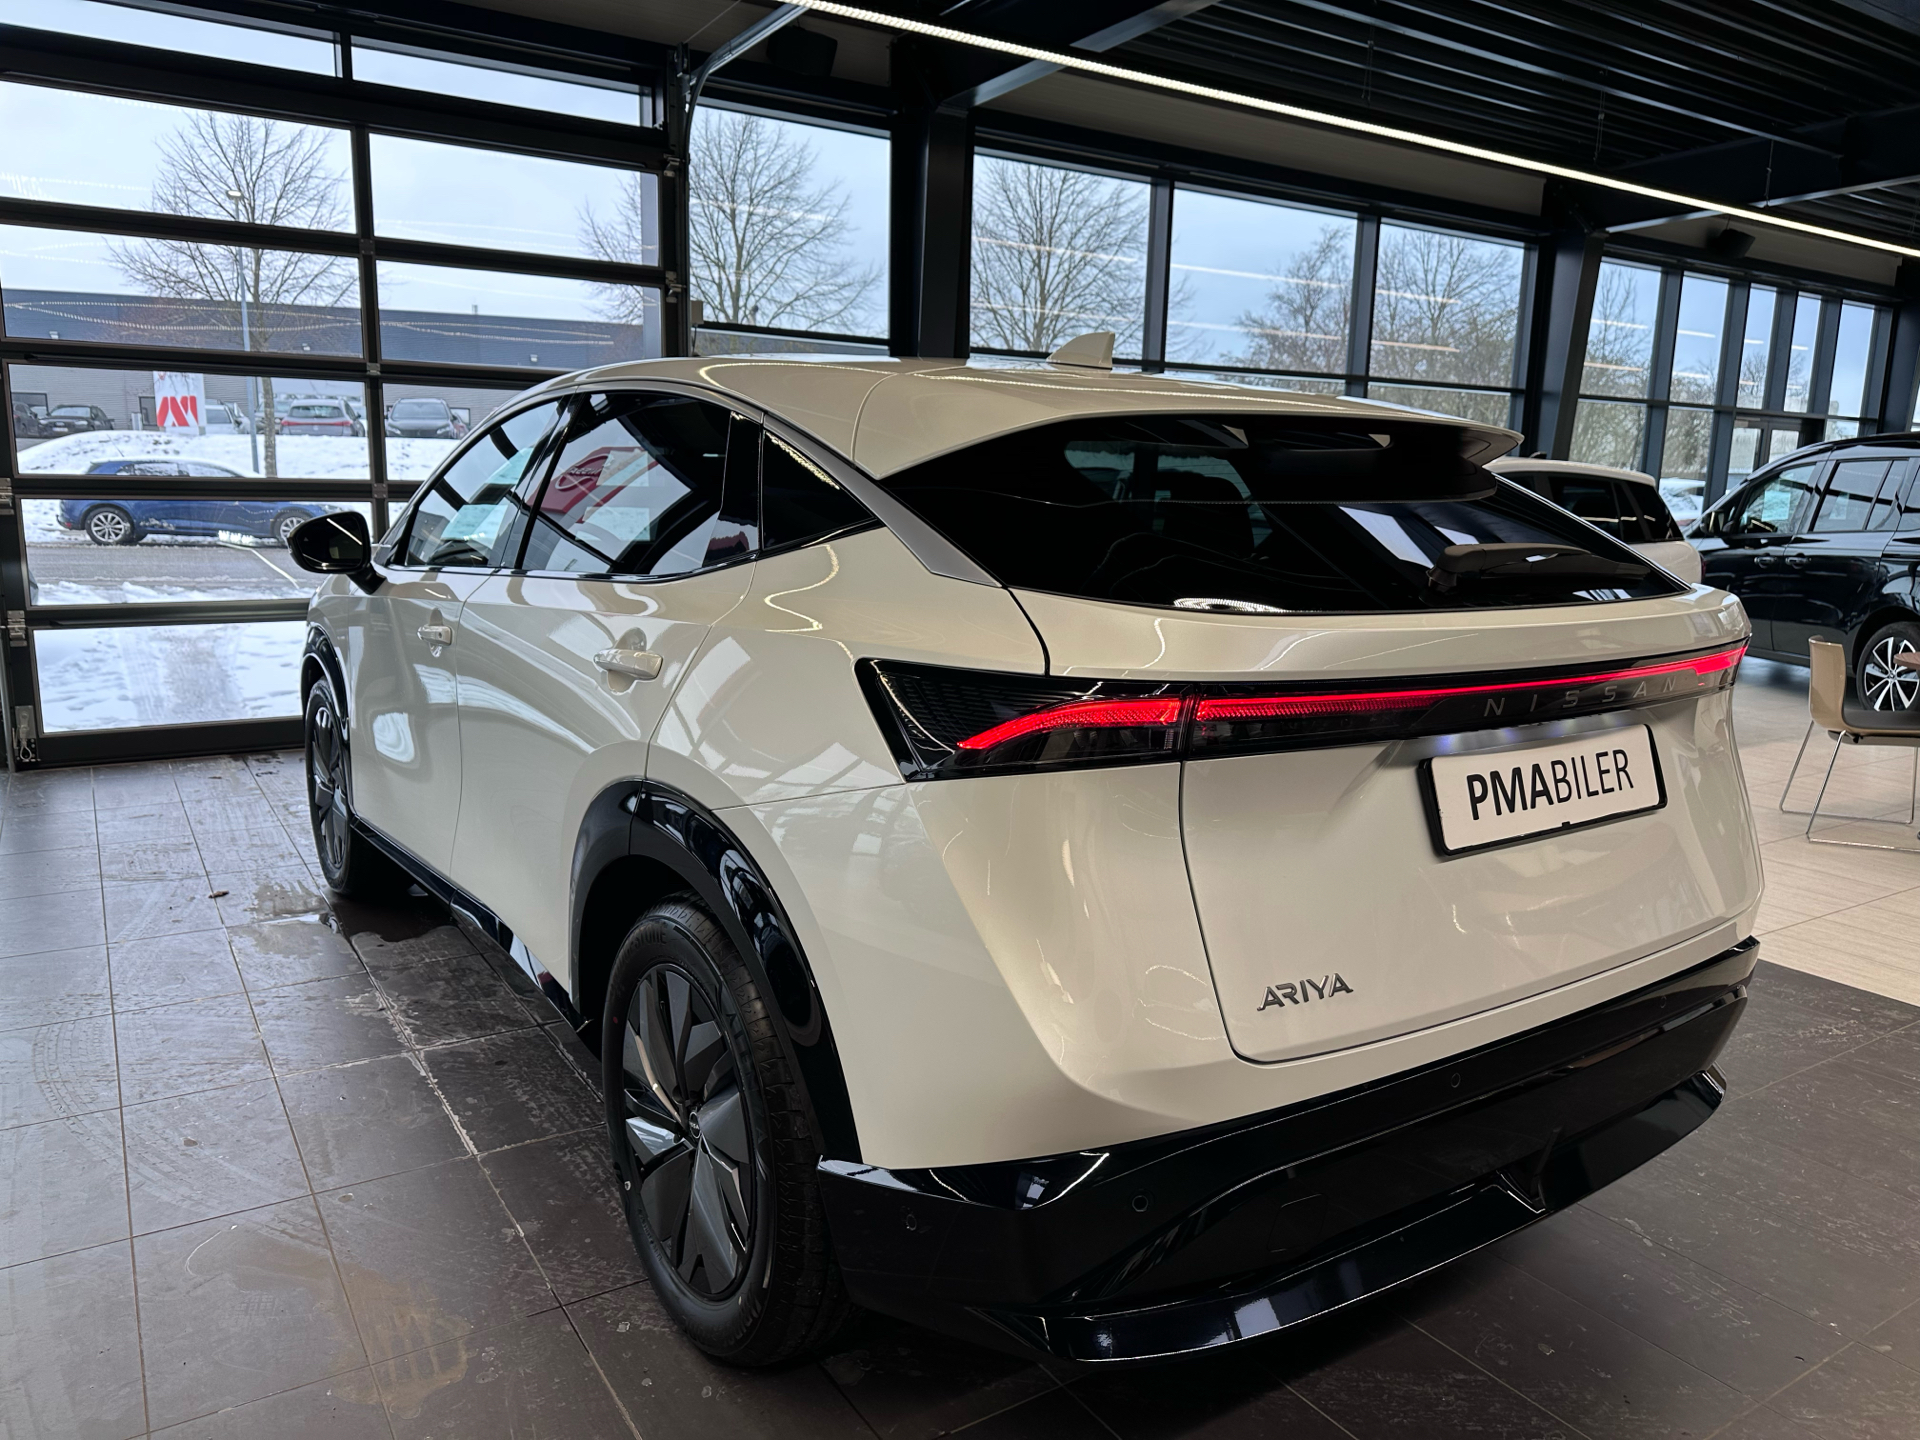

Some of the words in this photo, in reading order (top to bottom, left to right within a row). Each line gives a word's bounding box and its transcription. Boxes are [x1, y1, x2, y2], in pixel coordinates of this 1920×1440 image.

[1483, 675, 1677, 717] NISSAN
[1466, 748, 1634, 821] PMABILER
[1257, 972, 1354, 1012] ARIYA
